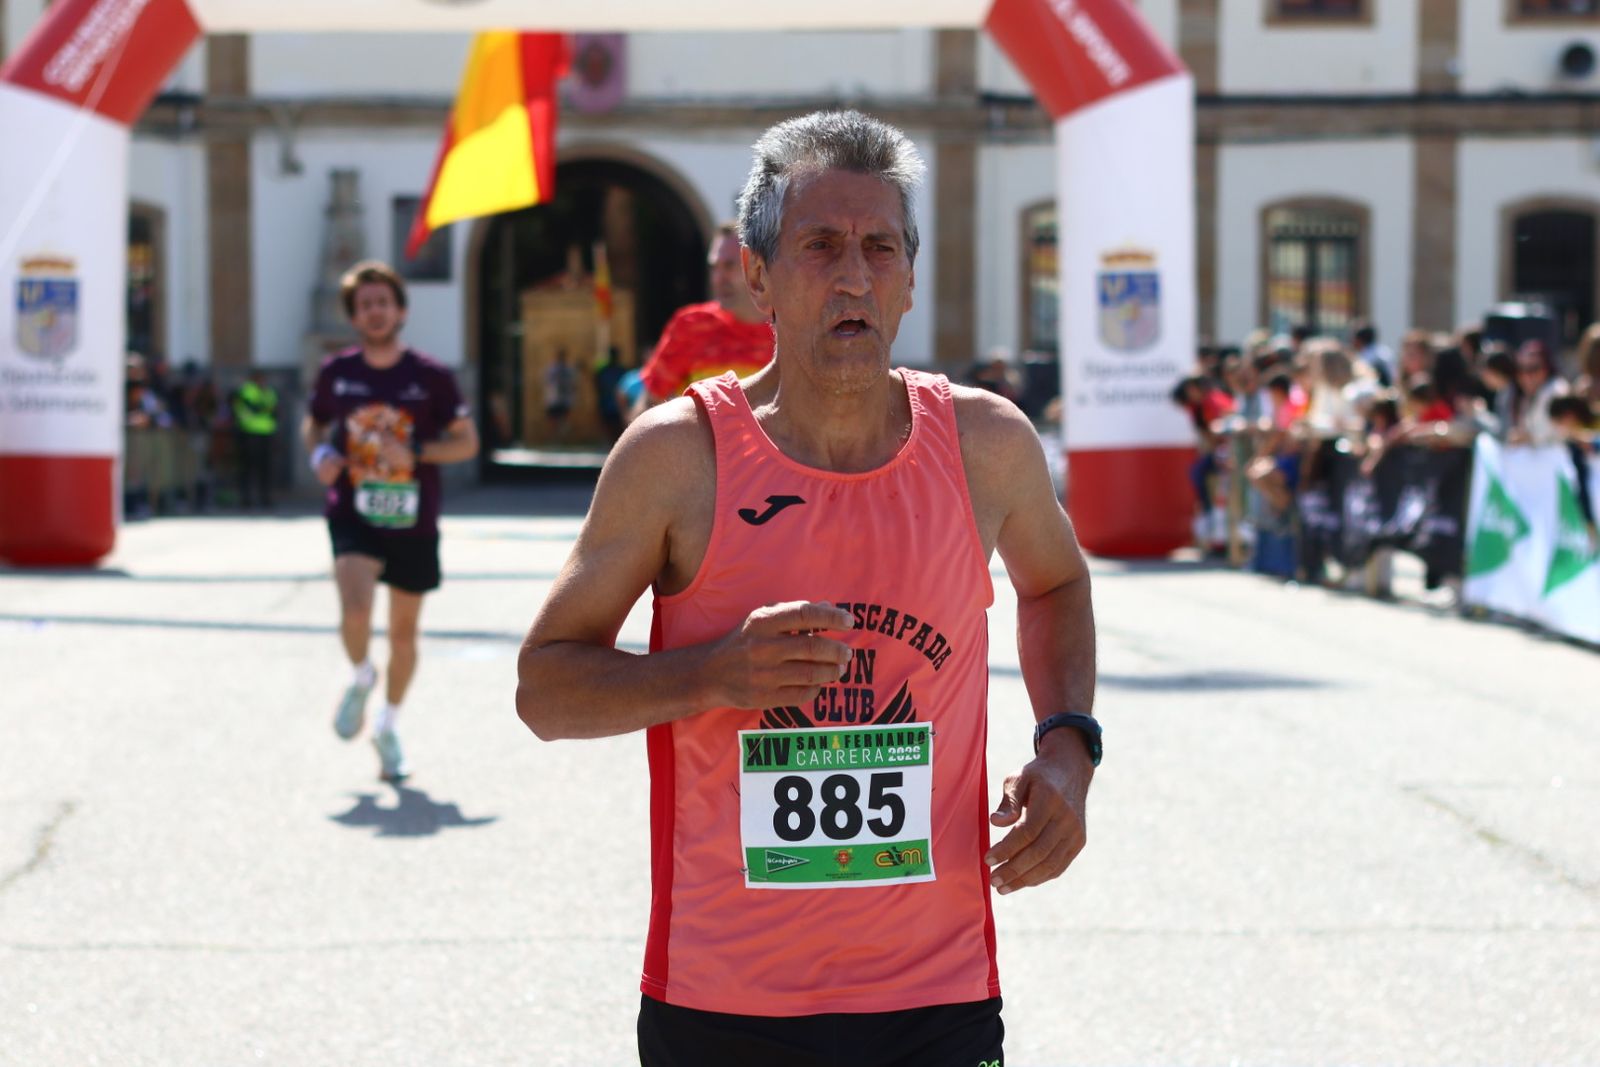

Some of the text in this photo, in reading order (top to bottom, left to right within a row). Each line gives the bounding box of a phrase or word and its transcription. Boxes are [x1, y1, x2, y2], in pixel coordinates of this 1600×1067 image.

[839, 648, 876, 685] UN
[814, 687, 875, 723] CLUB
[746, 737, 791, 766] XIV
[796, 731, 926, 750] SAN FERNANDO
[796, 745, 921, 766] CARRERA 2026
[773, 771, 906, 842] 885
